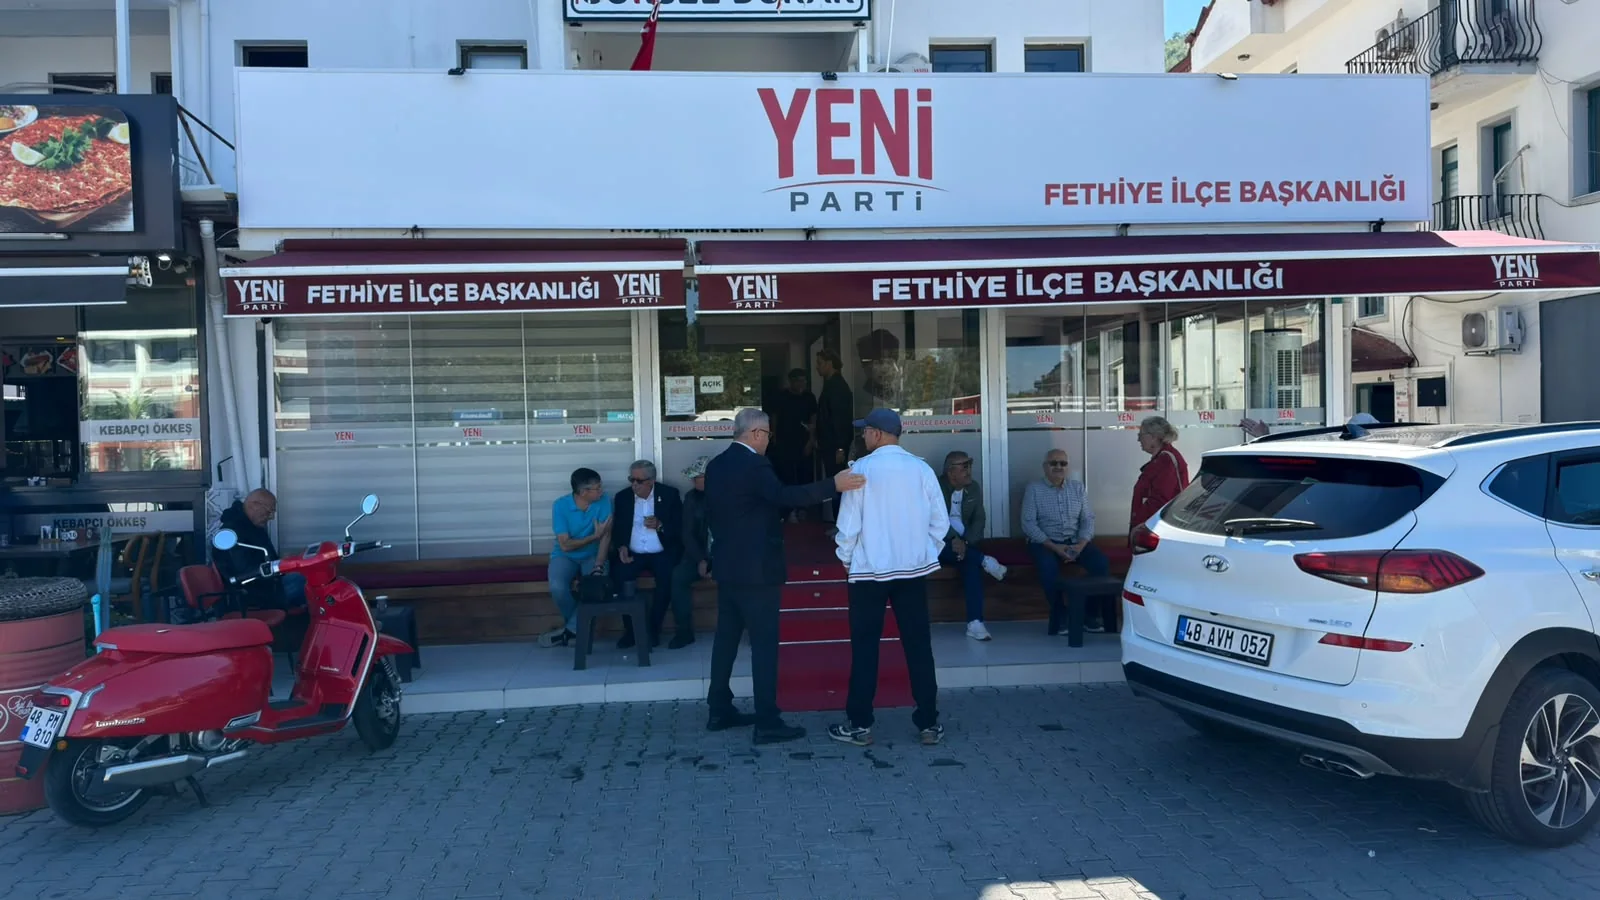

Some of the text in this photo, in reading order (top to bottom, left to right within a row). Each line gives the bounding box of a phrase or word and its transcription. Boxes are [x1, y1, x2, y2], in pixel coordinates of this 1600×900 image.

[1045, 173, 1405, 208] FETHİYE İLÇE BAŞKANLIĞI
[307, 276, 600, 305] FETHİYE İLÇE BAŞKANLIĞI
[872, 262, 1284, 301] FETHİYE İLÇE BAŞKANLIĞI
[702, 380, 721, 389] AÇIK
[100, 422, 192, 436] KEBAPÇI ÖKKEŞ
[1185, 621, 1202, 642] 48
[1207, 626, 1234, 650] AVM
[1240, 633, 1268, 658] 052
[30, 709, 60, 729] 48 PM
[33, 728, 52, 744] 810
